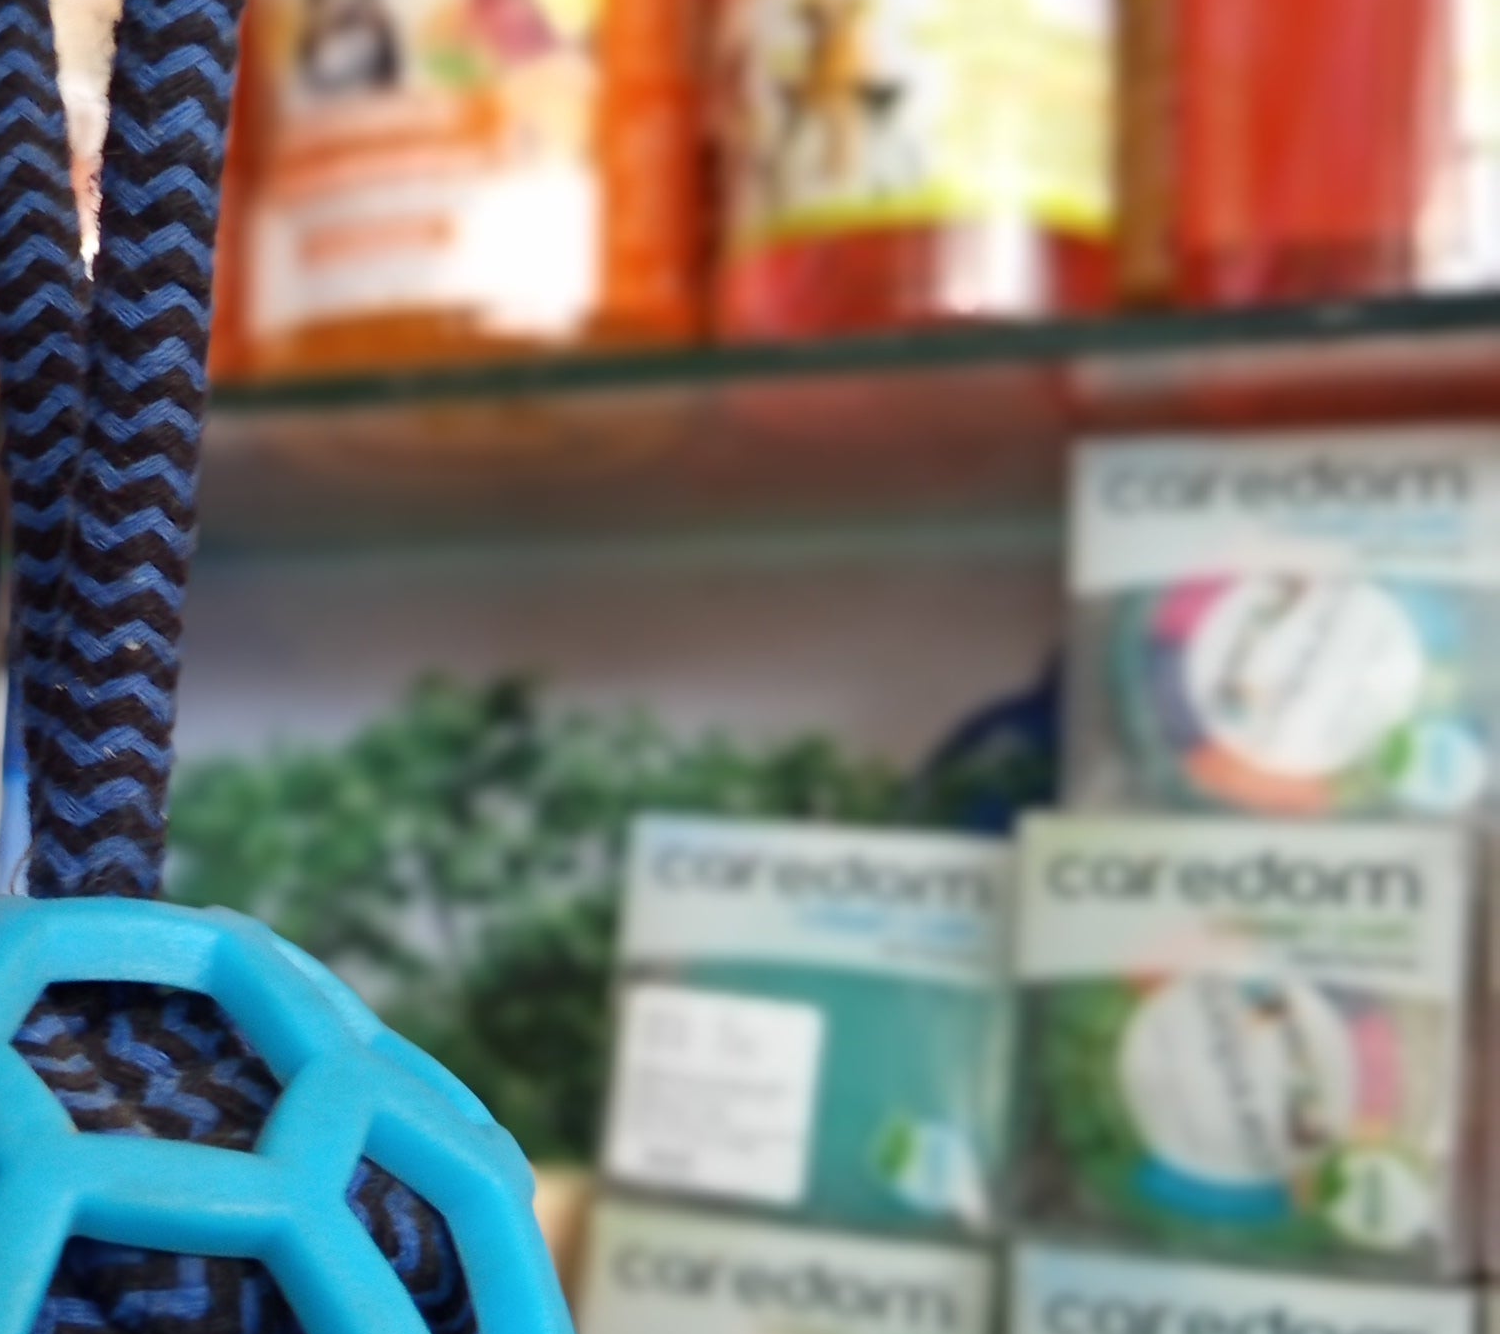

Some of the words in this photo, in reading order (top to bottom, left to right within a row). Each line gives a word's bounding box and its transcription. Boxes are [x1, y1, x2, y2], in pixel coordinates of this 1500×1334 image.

[652, 841, 998, 913] caredom
[1047, 847, 1422, 909] caredom
[612, 1244, 956, 1331] caredom
